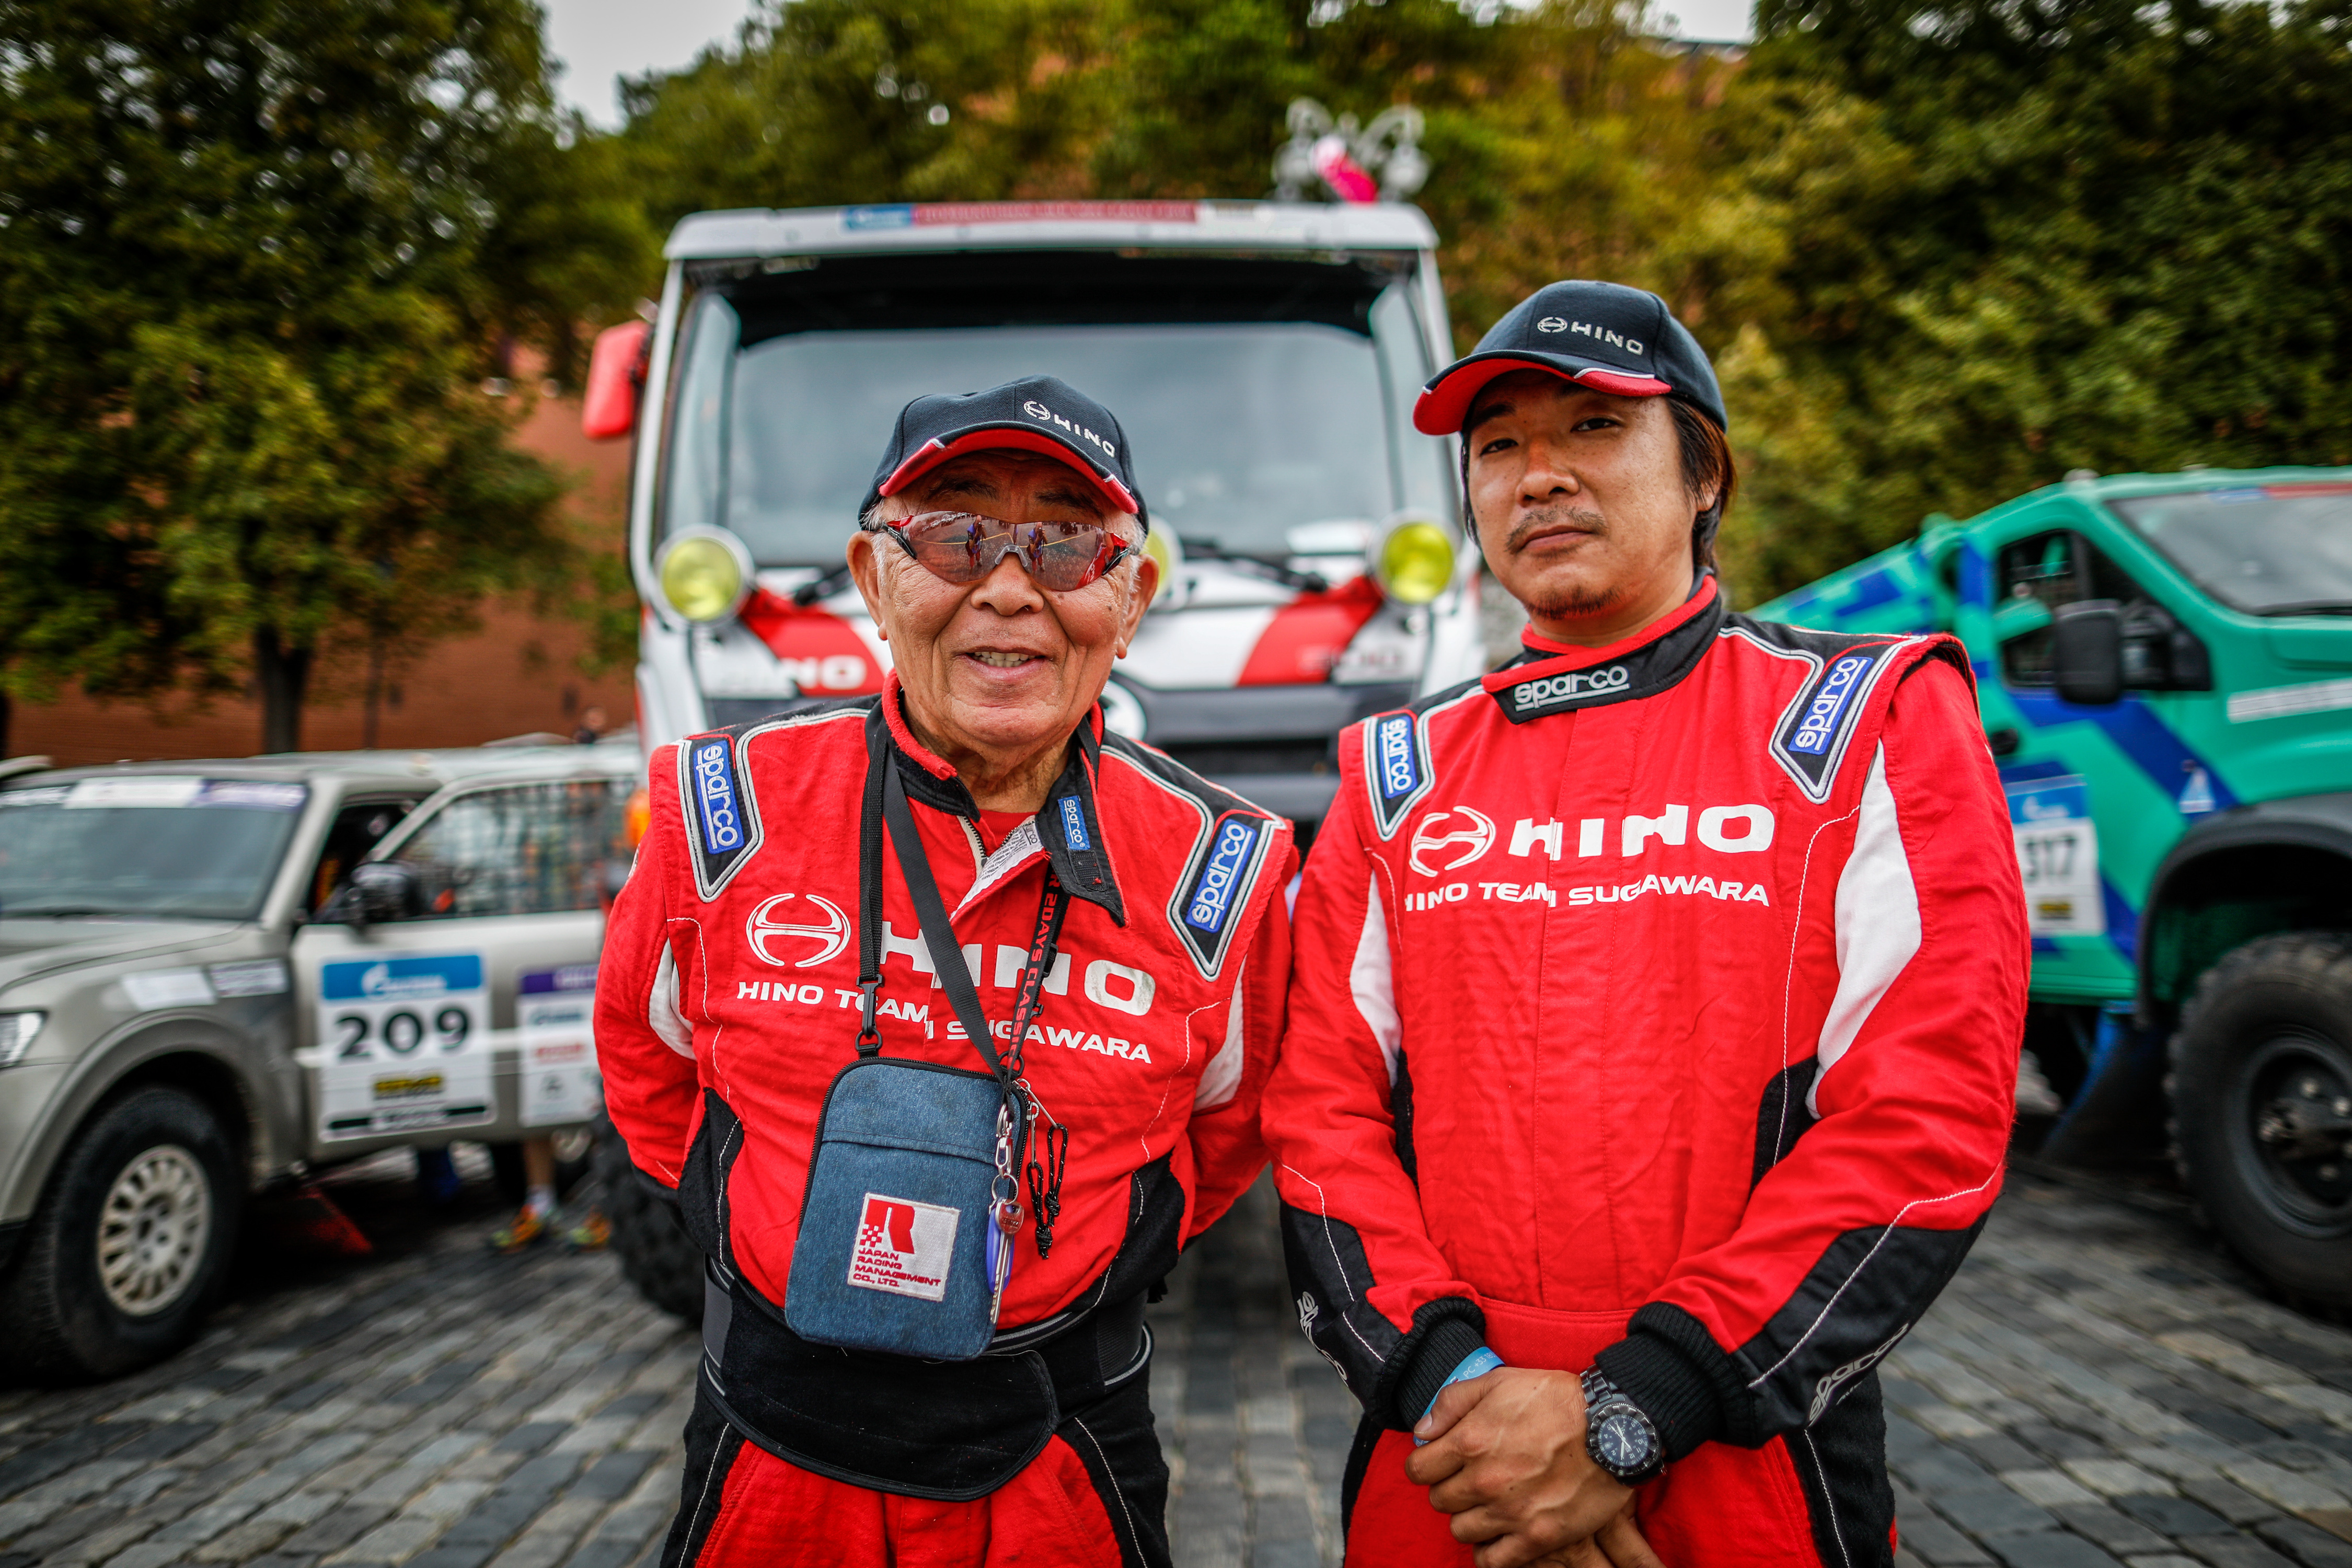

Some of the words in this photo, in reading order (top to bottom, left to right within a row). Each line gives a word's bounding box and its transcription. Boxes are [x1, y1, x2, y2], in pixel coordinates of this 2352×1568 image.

[1571, 321, 1644, 355] HINO
[1054, 414, 1115, 458] HINO
[1514, 665, 1630, 711] sparco
[1795, 659, 1863, 751] sparco
[1380, 719, 1412, 794] sparco
[696, 745, 738, 848] sparco
[1508, 803, 1775, 861] HINO
[1192, 824, 1252, 928] sparco
[1478, 882, 1556, 907] TEAM
[1569, 874, 1770, 907] SUGAWARA
[1031, 893, 1058, 962] 2DAYS
[736, 982, 824, 1005] HINO
[336, 1004, 471, 1057] 209
[855, 1264, 941, 1286] MANAGEMENT
[857, 1255, 902, 1270] RACING
[858, 1247, 899, 1261] JAPAN
[878, 1277, 900, 1287] LTD.
